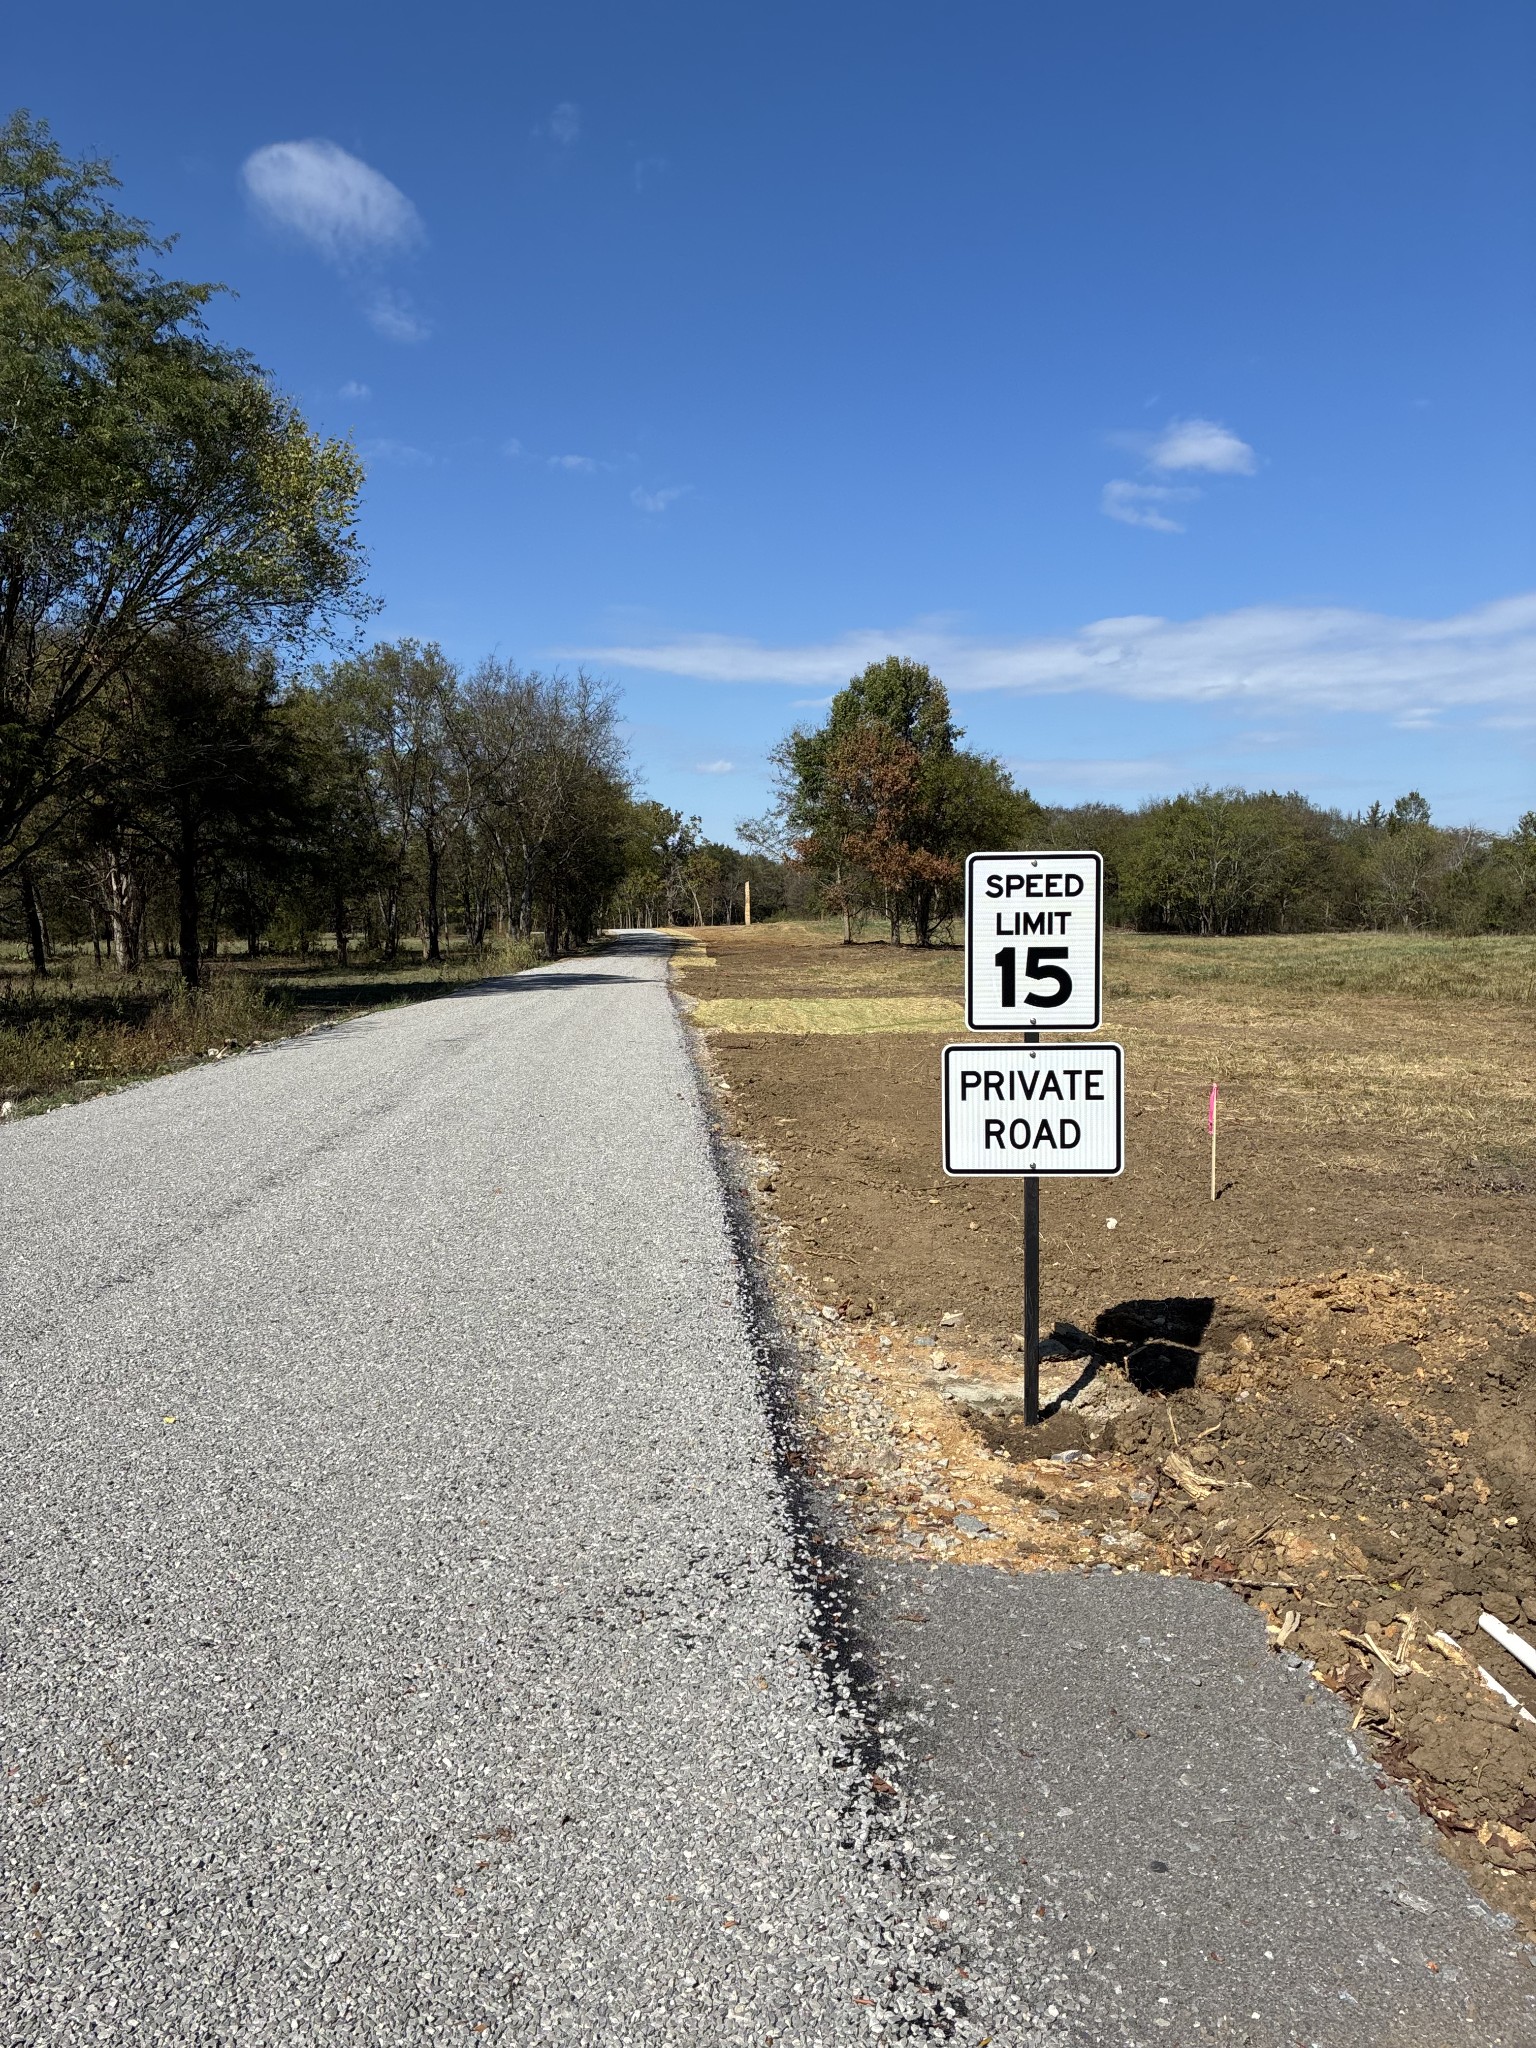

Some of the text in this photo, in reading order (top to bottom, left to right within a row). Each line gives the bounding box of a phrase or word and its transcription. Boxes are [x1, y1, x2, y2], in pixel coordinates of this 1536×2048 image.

[986, 873, 1084, 898] SPEED
[996, 911, 1072, 936] LIMIT
[994, 946, 1073, 1009] 15
[960, 1069, 1105, 1101] PRIVATE
[984, 1118, 1081, 1150] ROAD
